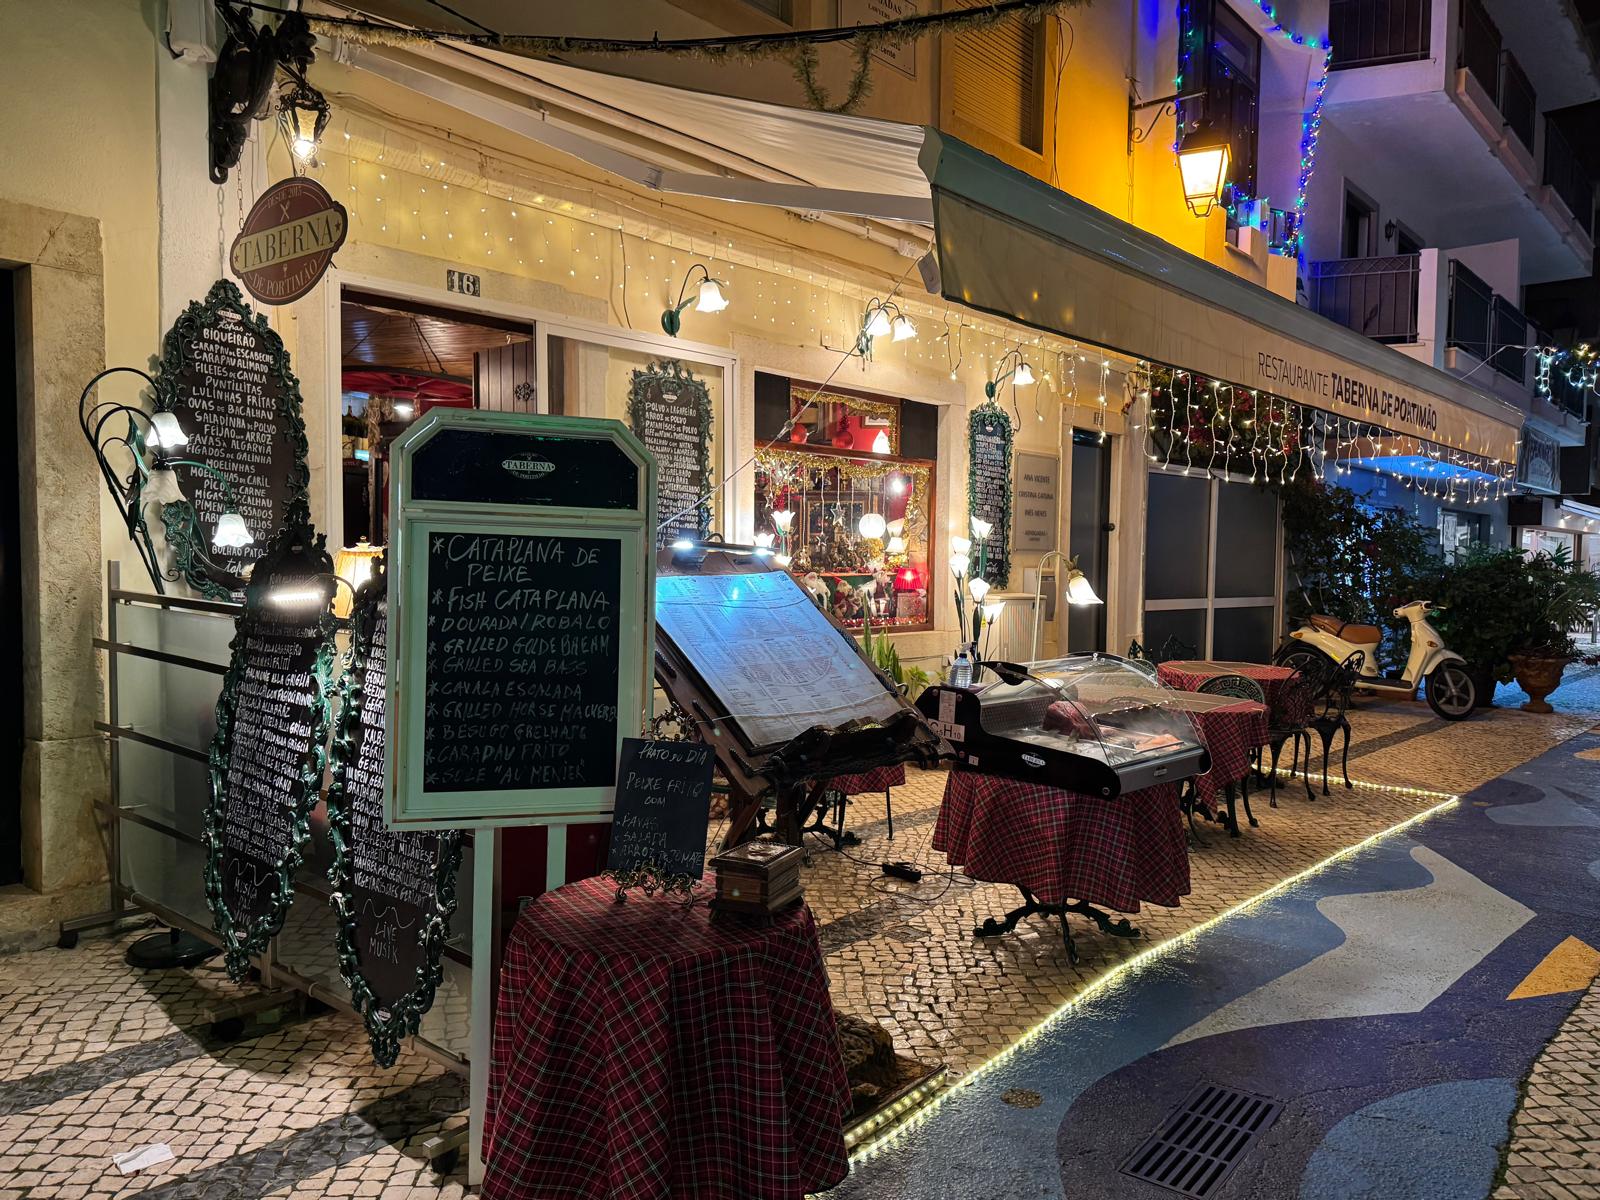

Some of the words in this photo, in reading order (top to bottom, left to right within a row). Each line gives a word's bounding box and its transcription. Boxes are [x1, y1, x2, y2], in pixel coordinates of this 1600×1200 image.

[240, 214, 334, 269] TABERNA
[252, 273, 265, 292] DE
[266, 258, 318, 296] PORTIMÃO
[449, 271, 475, 295] 16
[203, 328, 255, 348] BIQUEIRÃO
[237, 348, 274, 364] ESCABECHE
[195, 362, 228, 377] FILETES
[237, 370, 267, 384] CAVALA
[237, 359, 269, 374] ALIMADO
[205, 376, 262, 395] PUNTILLITAS
[1258, 352, 1329, 397] RESTAURANTE
[1331, 372, 1379, 411] TABERNA
[1380, 390, 1393, 418] DE
[1394, 395, 1437, 432] PORTIMÃO
[192, 386, 241, 404] LULINHAS
[247, 395, 277, 410] FRITAS
[188, 397, 215, 411] OVAS
[227, 405, 274, 420] BACALHAU
[195, 411, 246, 429] SALADINHA
[254, 421, 277, 434] POLVO
[189, 433, 220, 447] FAVAS
[231, 440, 272, 455] ALGARVIA
[245, 433, 273, 445] ARROZ
[186, 444, 225, 458] FIGADOS
[236, 452, 272, 465] GALINHA
[206, 458, 255, 474] MOELINHAS
[505, 460, 551, 471] TABERNA
[204, 479, 229, 492] PICO
[239, 485, 266, 497] CARNE
[247, 475, 271, 488] CARIL
[195, 489, 224, 501] MIGAS
[195, 499, 225, 512] PIMEN
[238, 505, 273, 520] ASSADOS
[245, 518, 272, 530] UEIJOS
[244, 547, 263, 558] PATO
[448, 535, 565, 563] CATAPLANA
[572, 548, 599, 567] DE
[223, 558, 243, 578] tap
[468, 563, 532, 586] PEIXE
[448, 587, 487, 612] FISH
[495, 590, 610, 611] CATAPLANA
[443, 636, 508, 654] GRILLED
[443, 656, 503, 674] GRILLED
[509, 658, 537, 674] SEA
[544, 659, 587, 676] BASS
[285, 669, 310, 687] GRIGLIA
[441, 681, 500, 698] CAVALA
[443, 701, 502, 720] GRILLED
[509, 703, 557, 719] HORSE
[290, 721, 311, 737] GRIGLIA
[287, 737, 309, 753] GRIGLIA
[360, 742, 385, 760] GEGRIL
[638, 740, 669, 761] PRATO
[684, 748, 707, 766] DIA
[281, 763, 300, 780] FORNO
[358, 756, 385, 775] GEGRIL
[273, 774, 292, 792] FORNO
[625, 772, 663, 791] PEIXE
[644, 796, 666, 806] COM
[398, 842, 434, 864] MILANESE
[375, 921, 398, 943] LIVE
[369, 937, 399, 965] MUSIK
